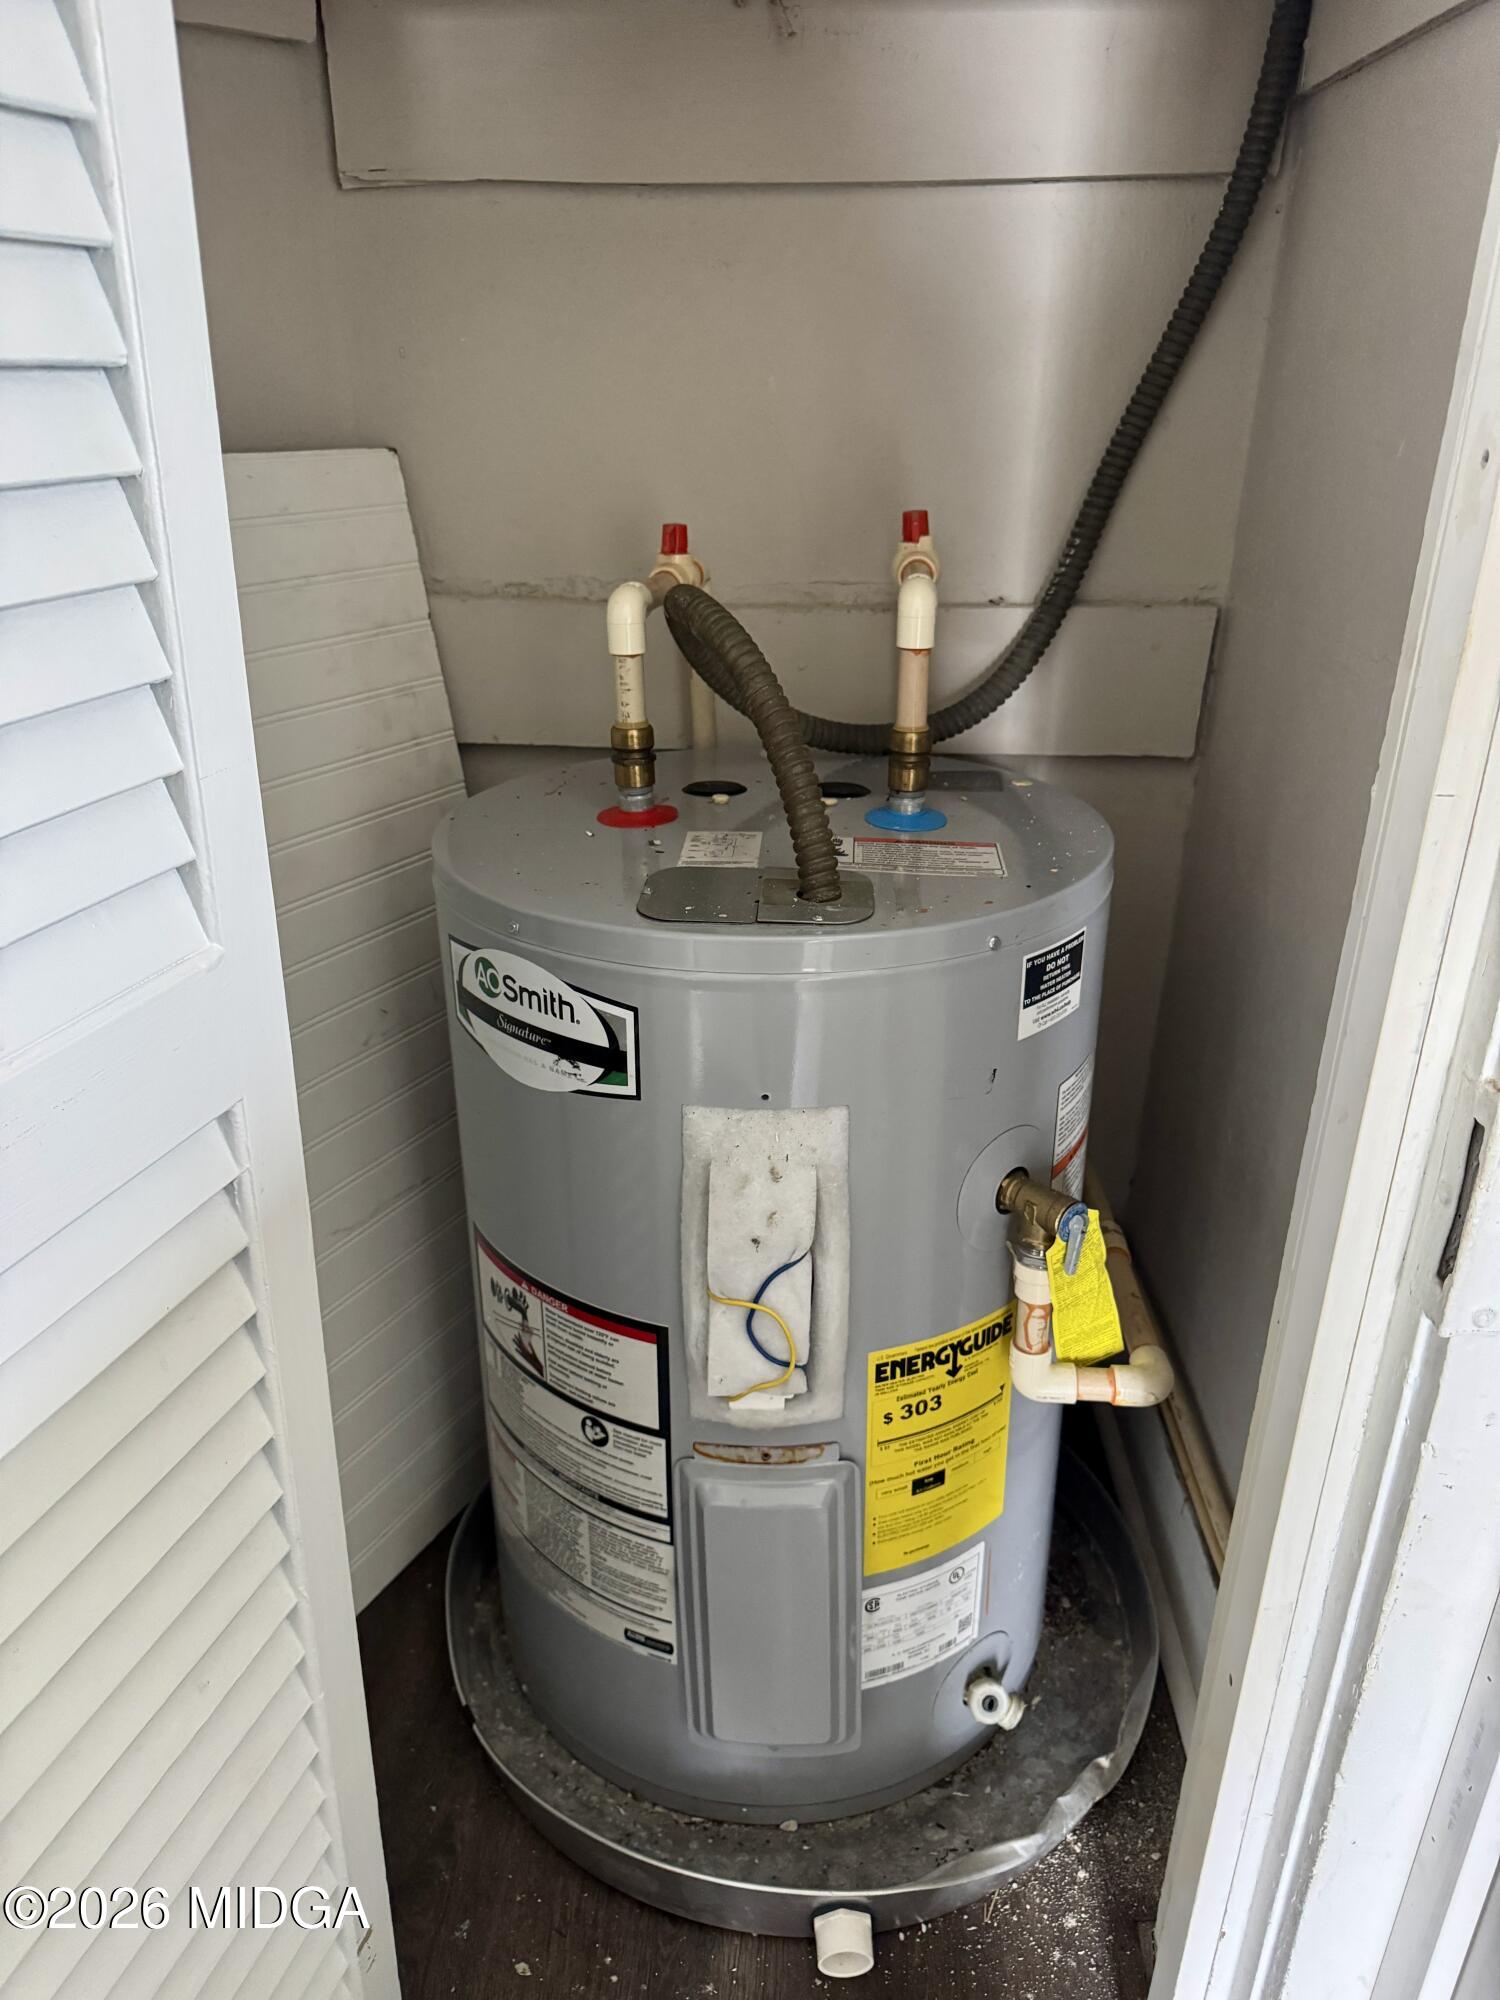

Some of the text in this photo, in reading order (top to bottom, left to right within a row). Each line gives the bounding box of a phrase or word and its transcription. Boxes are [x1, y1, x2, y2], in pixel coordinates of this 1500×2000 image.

[1026, 961, 1033, 969] IF
[1034, 956, 1045, 966] YOU
[1046, 949, 1061, 961] HAVE
[1046, 953, 1070, 972] DO NOT
[1041, 986, 1056, 999] PLACE
[875, 1314, 1014, 1383] ENERGYGUIDE
[896, 1389, 927, 1402] Estimated
[928, 1382, 946, 1394] Yearly
[947, 1375, 966, 1387] Energy
[967, 1368, 979, 1378] Cost
[883, 1394, 942, 1425] $ 303
[913, 1457, 932, 1467] First
[934, 1450, 952, 1461] Hour
[952, 1438, 975, 1452] Rating
